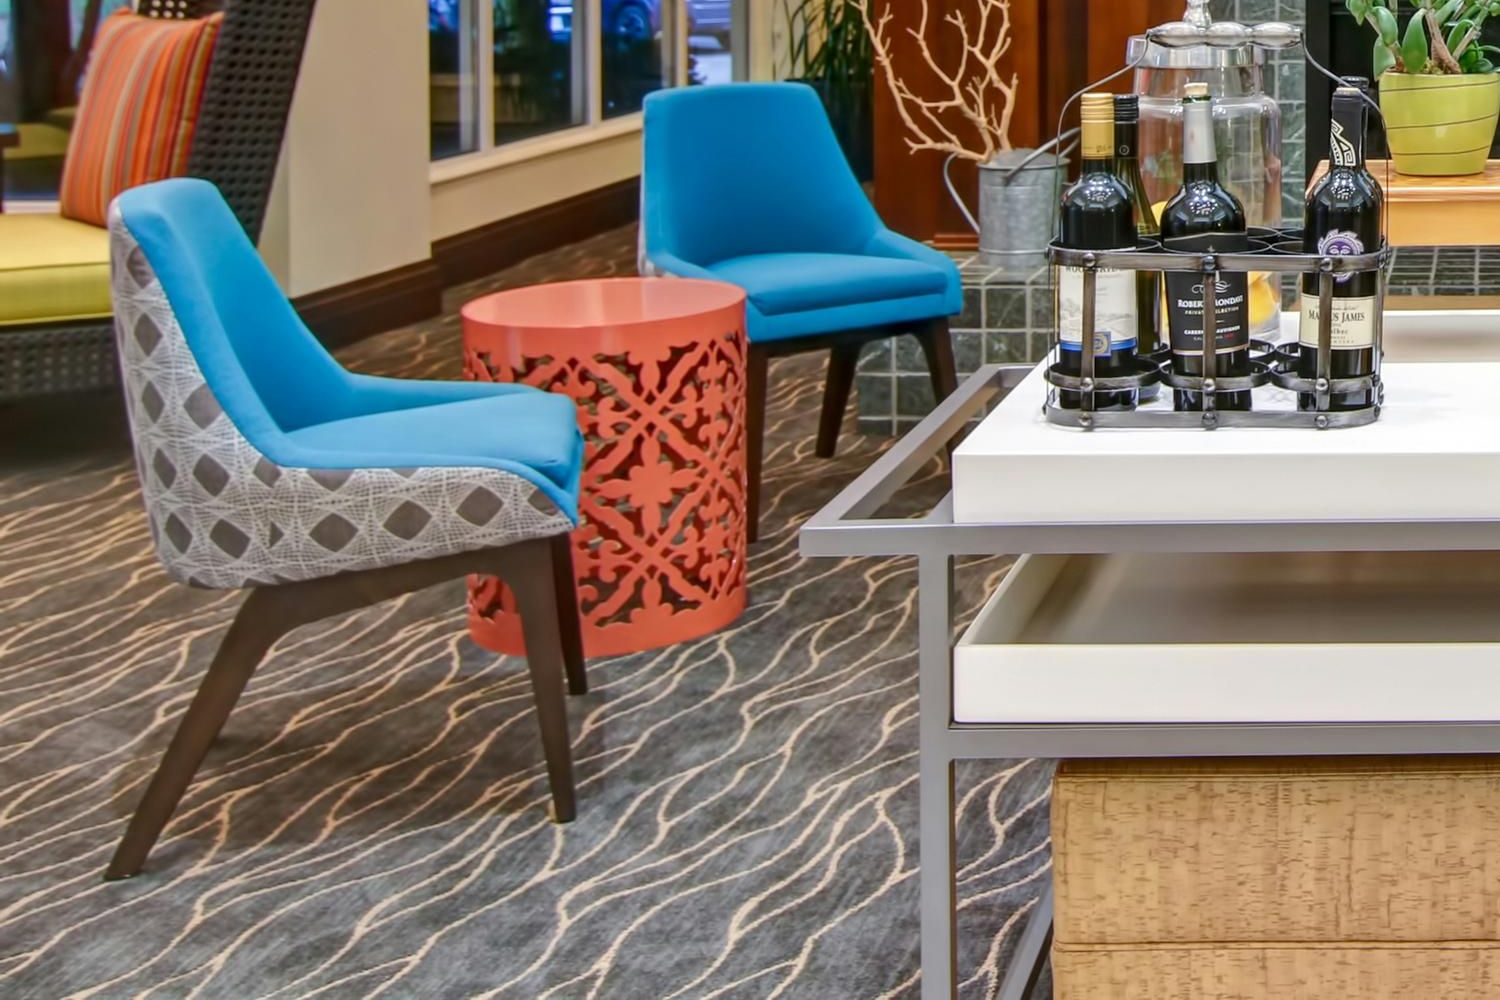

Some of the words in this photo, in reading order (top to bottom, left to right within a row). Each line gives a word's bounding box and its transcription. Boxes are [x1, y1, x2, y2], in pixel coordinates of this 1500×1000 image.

[1177, 299, 1204, 308] ROBER
[1215, 294, 1243, 307] ONDAVI
[1215, 306, 1239, 314] ELECTION
[1341, 312, 1365, 323] JAMES
